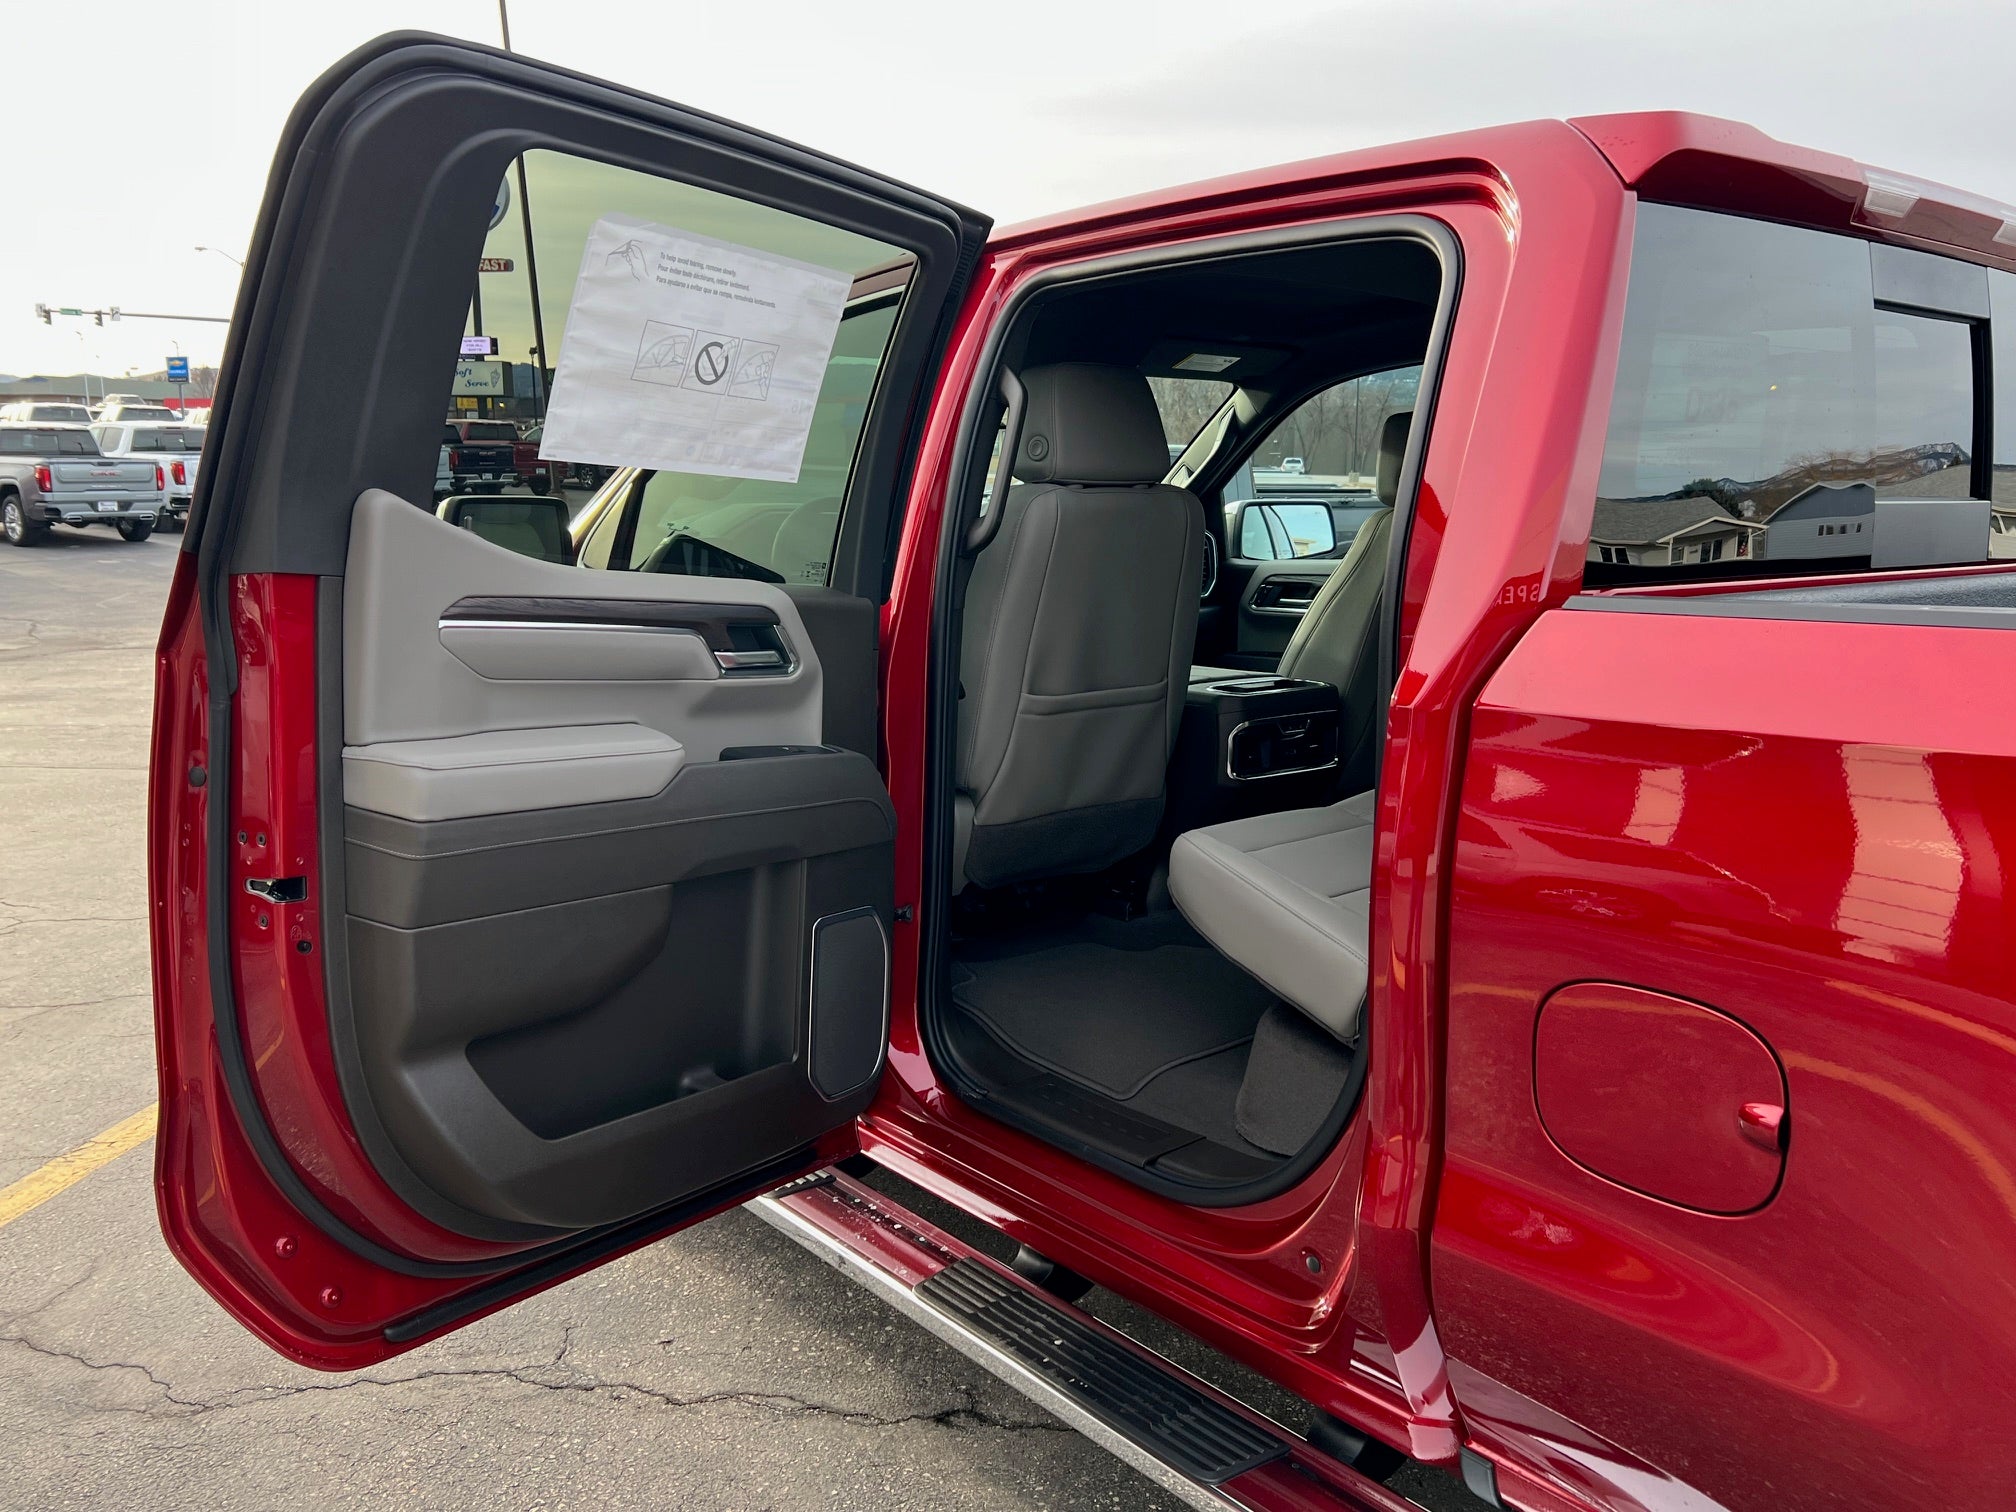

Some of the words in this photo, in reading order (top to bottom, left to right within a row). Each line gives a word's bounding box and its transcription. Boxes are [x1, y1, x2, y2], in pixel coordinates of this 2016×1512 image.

[666, 253, 677, 263] help
[658, 263, 669, 272] Pour
[656, 275, 667, 284] Para
[465, 379, 489, 388] Serve
